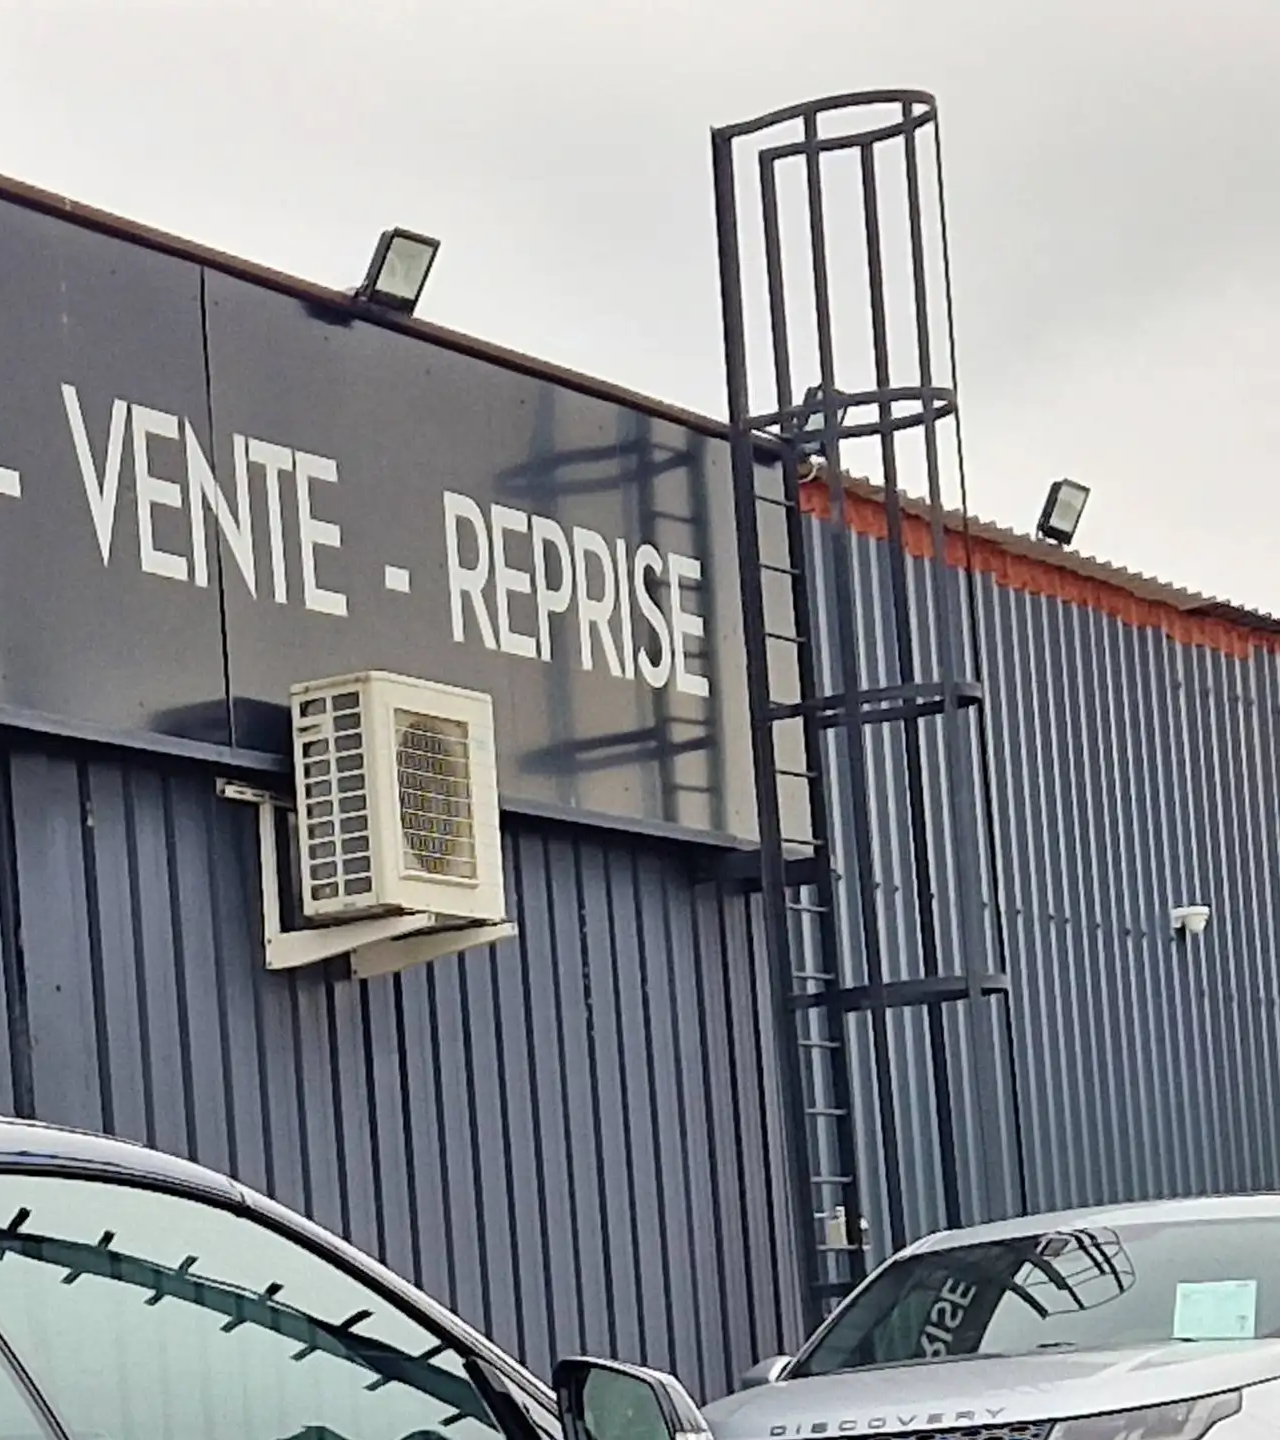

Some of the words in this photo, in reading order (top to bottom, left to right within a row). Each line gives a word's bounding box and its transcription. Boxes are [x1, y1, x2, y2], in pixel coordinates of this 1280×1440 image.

[60, 382, 349, 617] VENTE
[441, 489, 711, 699] REPRISE
[769, 1406, 1007, 1437] DISCOVERY
